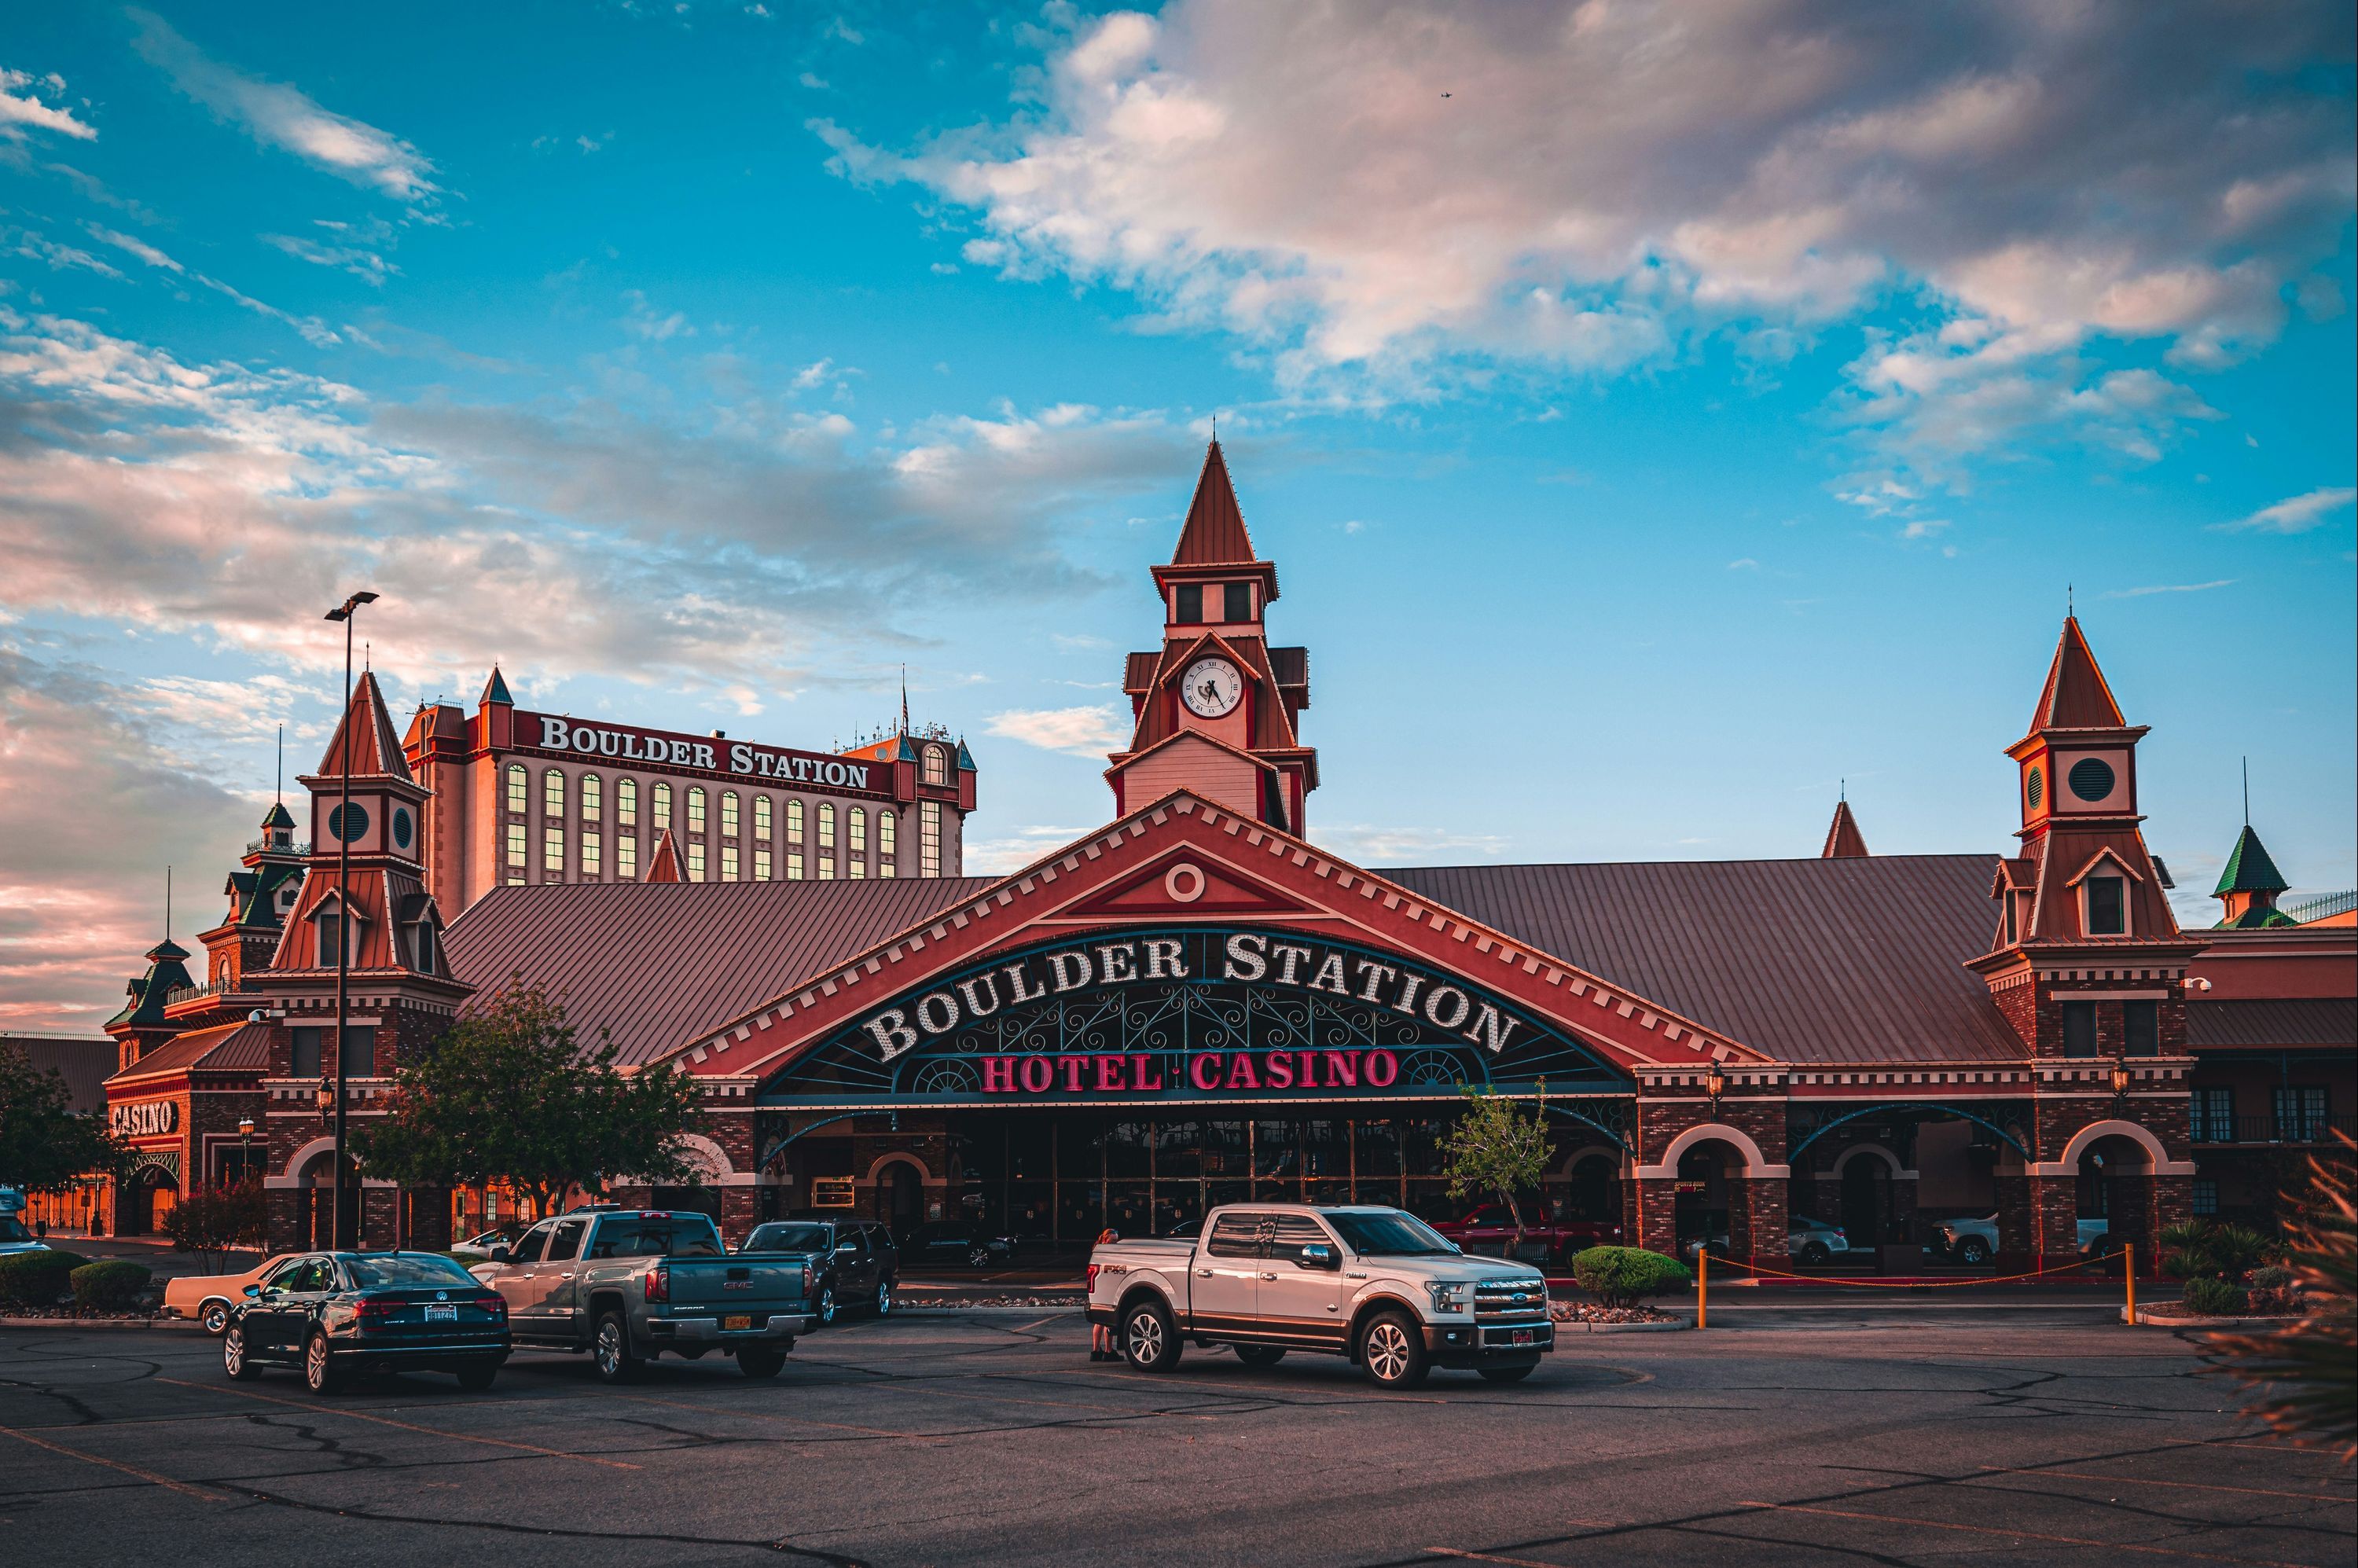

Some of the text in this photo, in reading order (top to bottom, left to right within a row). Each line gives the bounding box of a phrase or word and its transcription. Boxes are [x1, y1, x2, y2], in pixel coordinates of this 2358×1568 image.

[540, 717, 869, 788] BOULDER STATION
[862, 934, 1522, 1063] BOULDER STATION
[979, 1048, 1399, 1092] HOTEL CASINO
[112, 1101, 172, 1137] CASINO
[1104, 1265, 1126, 1274] FX4
